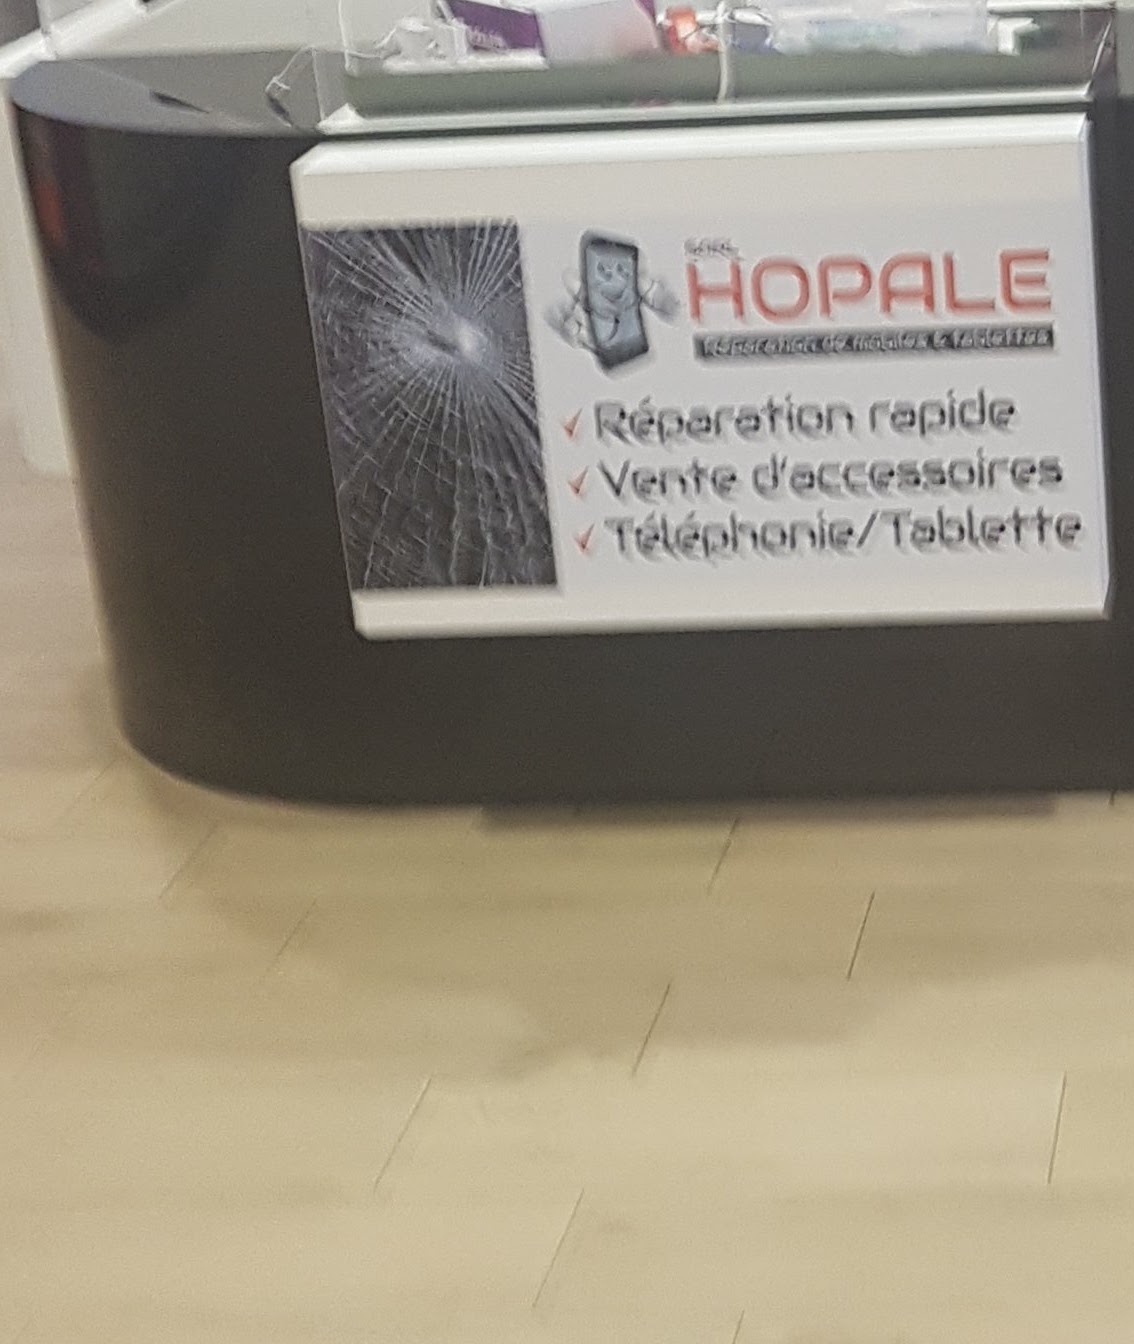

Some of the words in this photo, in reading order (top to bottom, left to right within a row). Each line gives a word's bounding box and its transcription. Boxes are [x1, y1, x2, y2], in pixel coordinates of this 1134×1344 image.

[686, 248, 1052, 324] HOPALE
[703, 335, 816, 357] Réparation
[852, 330, 928, 353] mobiles
[953, 325, 1051, 348] tablettes
[594, 393, 855, 446] Réparation
[868, 387, 1016, 438] rapide
[597, 456, 738, 502] Vente
[752, 447, 1064, 499] d'accessoires
[604, 504, 1083, 562] Téléphonie/Tablette
